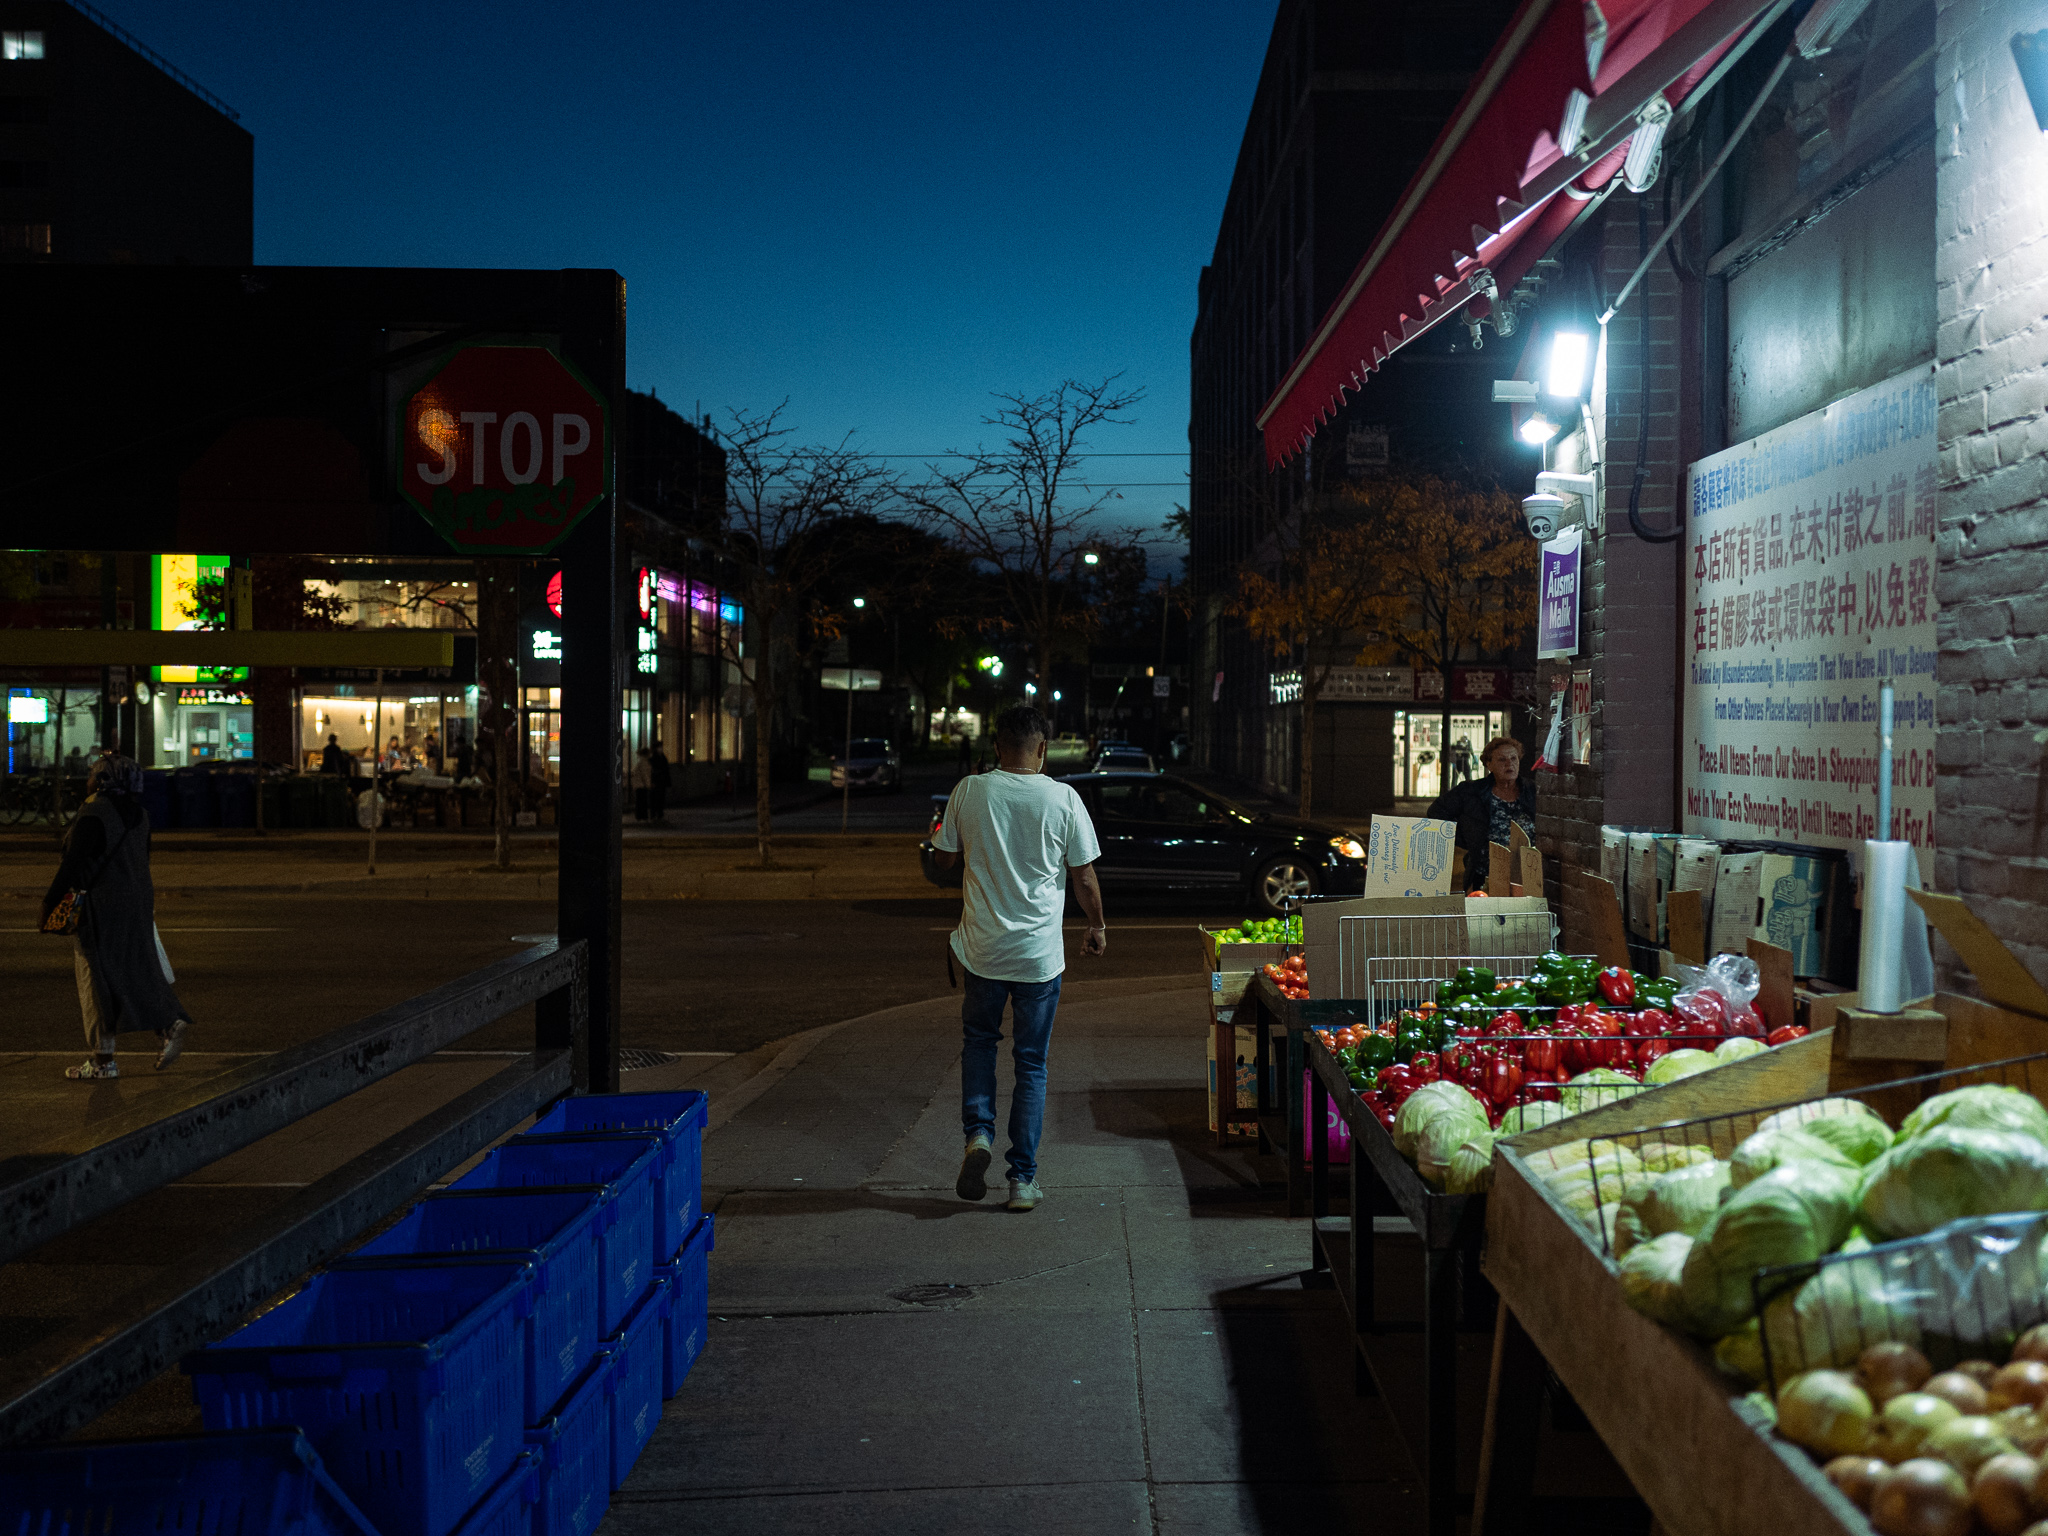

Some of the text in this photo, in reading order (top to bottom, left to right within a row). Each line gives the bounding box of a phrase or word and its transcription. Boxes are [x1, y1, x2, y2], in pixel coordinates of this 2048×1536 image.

[416, 409, 591, 487] STOP
[1547, 571, 1575, 599] Ausma
[1549, 597, 1571, 629] Malik
[1692, 663, 1699, 684] To
[1699, 662, 1712, 684] Avoid
[1713, 661, 1722, 690] Any
[1722, 659, 1774, 689] Misunderstanding,
[1776, 658, 1784, 682] We
[1785, 657, 1818, 688] Appreciate
[1820, 654, 1836, 680] That
[1838, 653, 1854, 680] You
[1856, 651, 1875, 678] Have
[1878, 649, 1888, 677] All
[1889, 648, 1907, 676] Your
[1574, 682, 1590, 714] FDC
[1715, 692, 1934, 729] From Other Stores Placed Securely In Your Own Eco pping Bag
[1699, 744, 1717, 773] Place
[1719, 744, 1728, 774] All
[1730, 745, 1750, 776] Items
[1753, 745, 1773, 777] From
[1775, 746, 1790, 779] Our
[1792, 746, 1816, 781] Store
[1818, 747, 1827, 782] In
[1830, 747, 1879, 795] Shopping
[1910, 748, 1923, 787] Or
[1687, 787, 1701, 817] Not
[1703, 789, 1710, 818] In
[1711, 789, 1726, 820] Your
[1728, 791, 1742, 823] Eco
[1743, 793, 1780, 837] Shopping
[1782, 797, 1799, 840] Bag
[1801, 799, 1822, 835] Until
[1824, 801, 1853, 839] Items
[1856, 804, 1875, 840] Are
[1905, 808, 1923, 848] For
[1774, 875, 1798, 905] Bell
